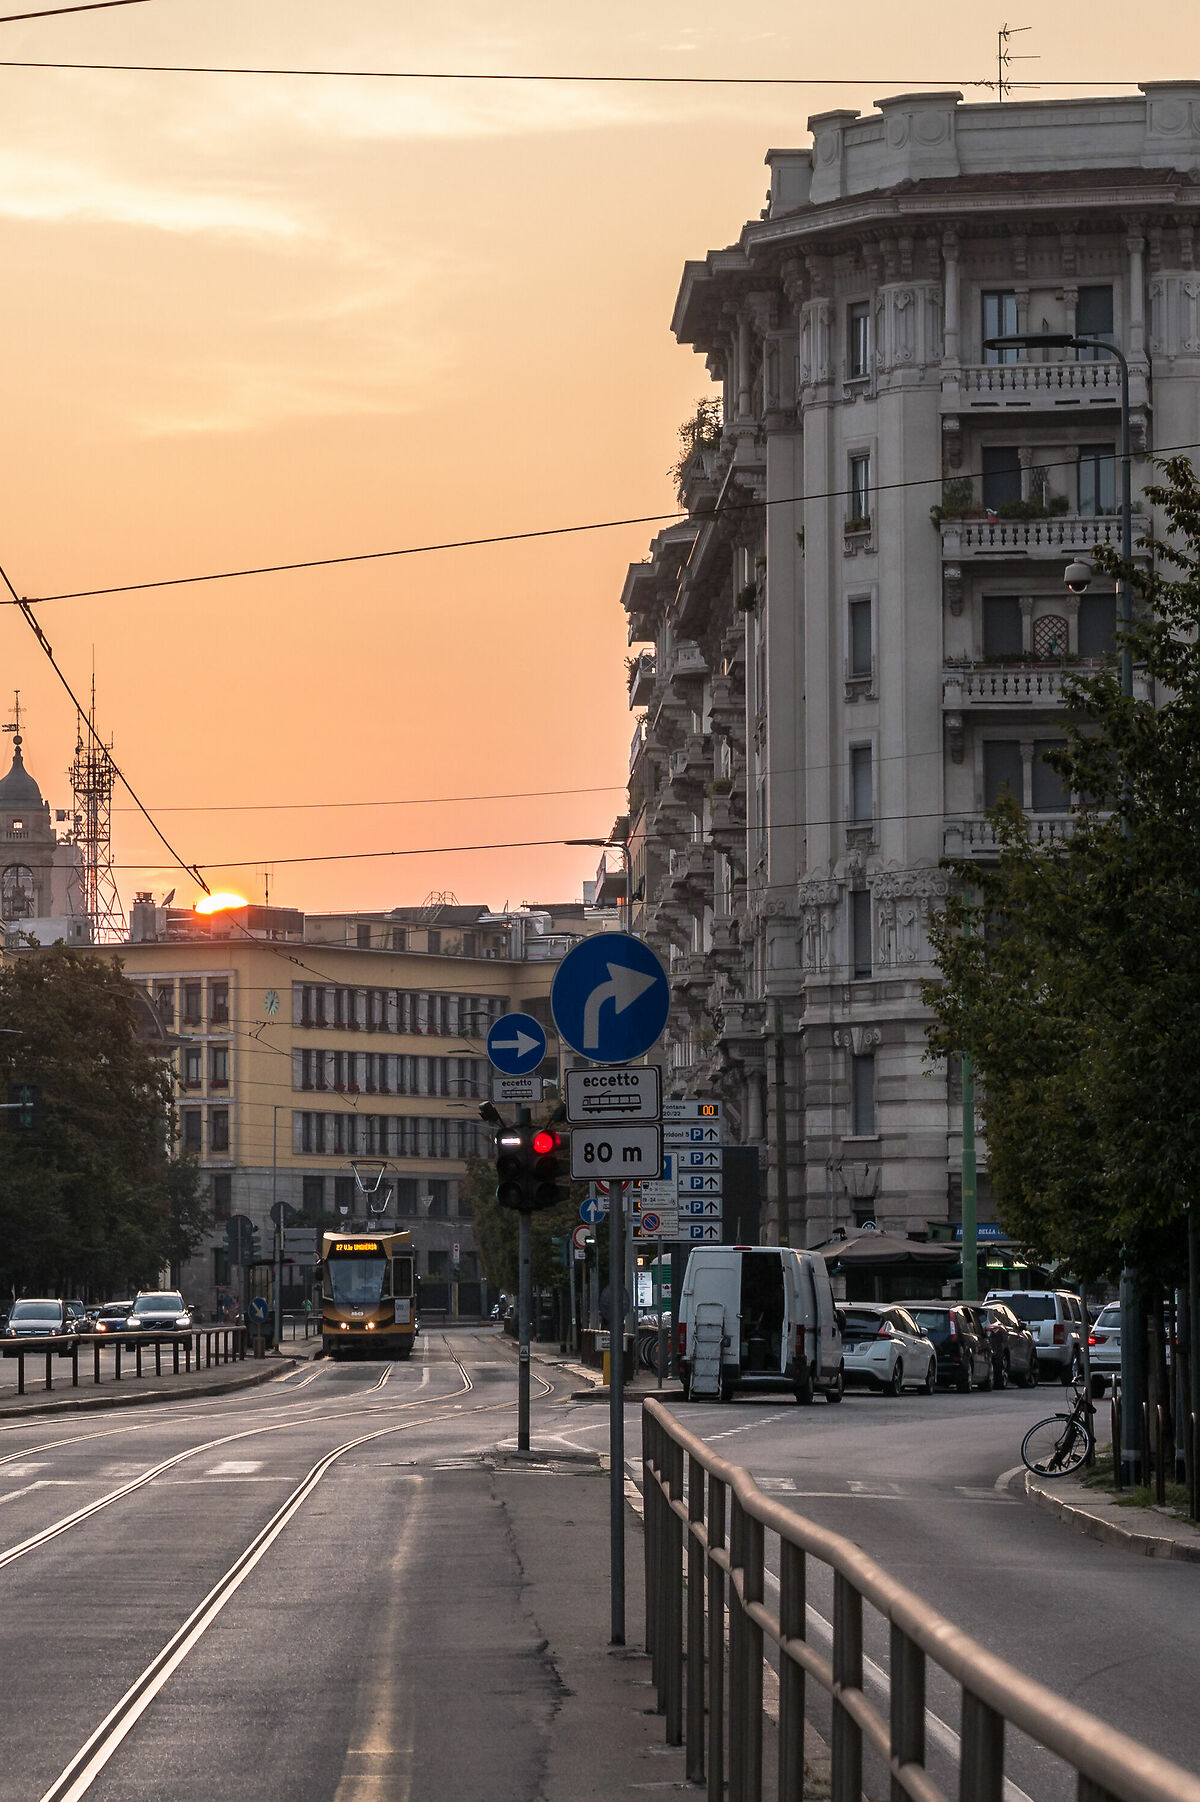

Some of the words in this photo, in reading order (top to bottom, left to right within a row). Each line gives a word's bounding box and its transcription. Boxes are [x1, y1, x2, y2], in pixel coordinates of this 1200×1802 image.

[501, 1079, 532, 1087] eccetto
[583, 1073, 639, 1087] eccetto
[702, 1105, 715, 1116] 00
[583, 1142, 613, 1163] 80
[622, 1146, 642, 1162] m
